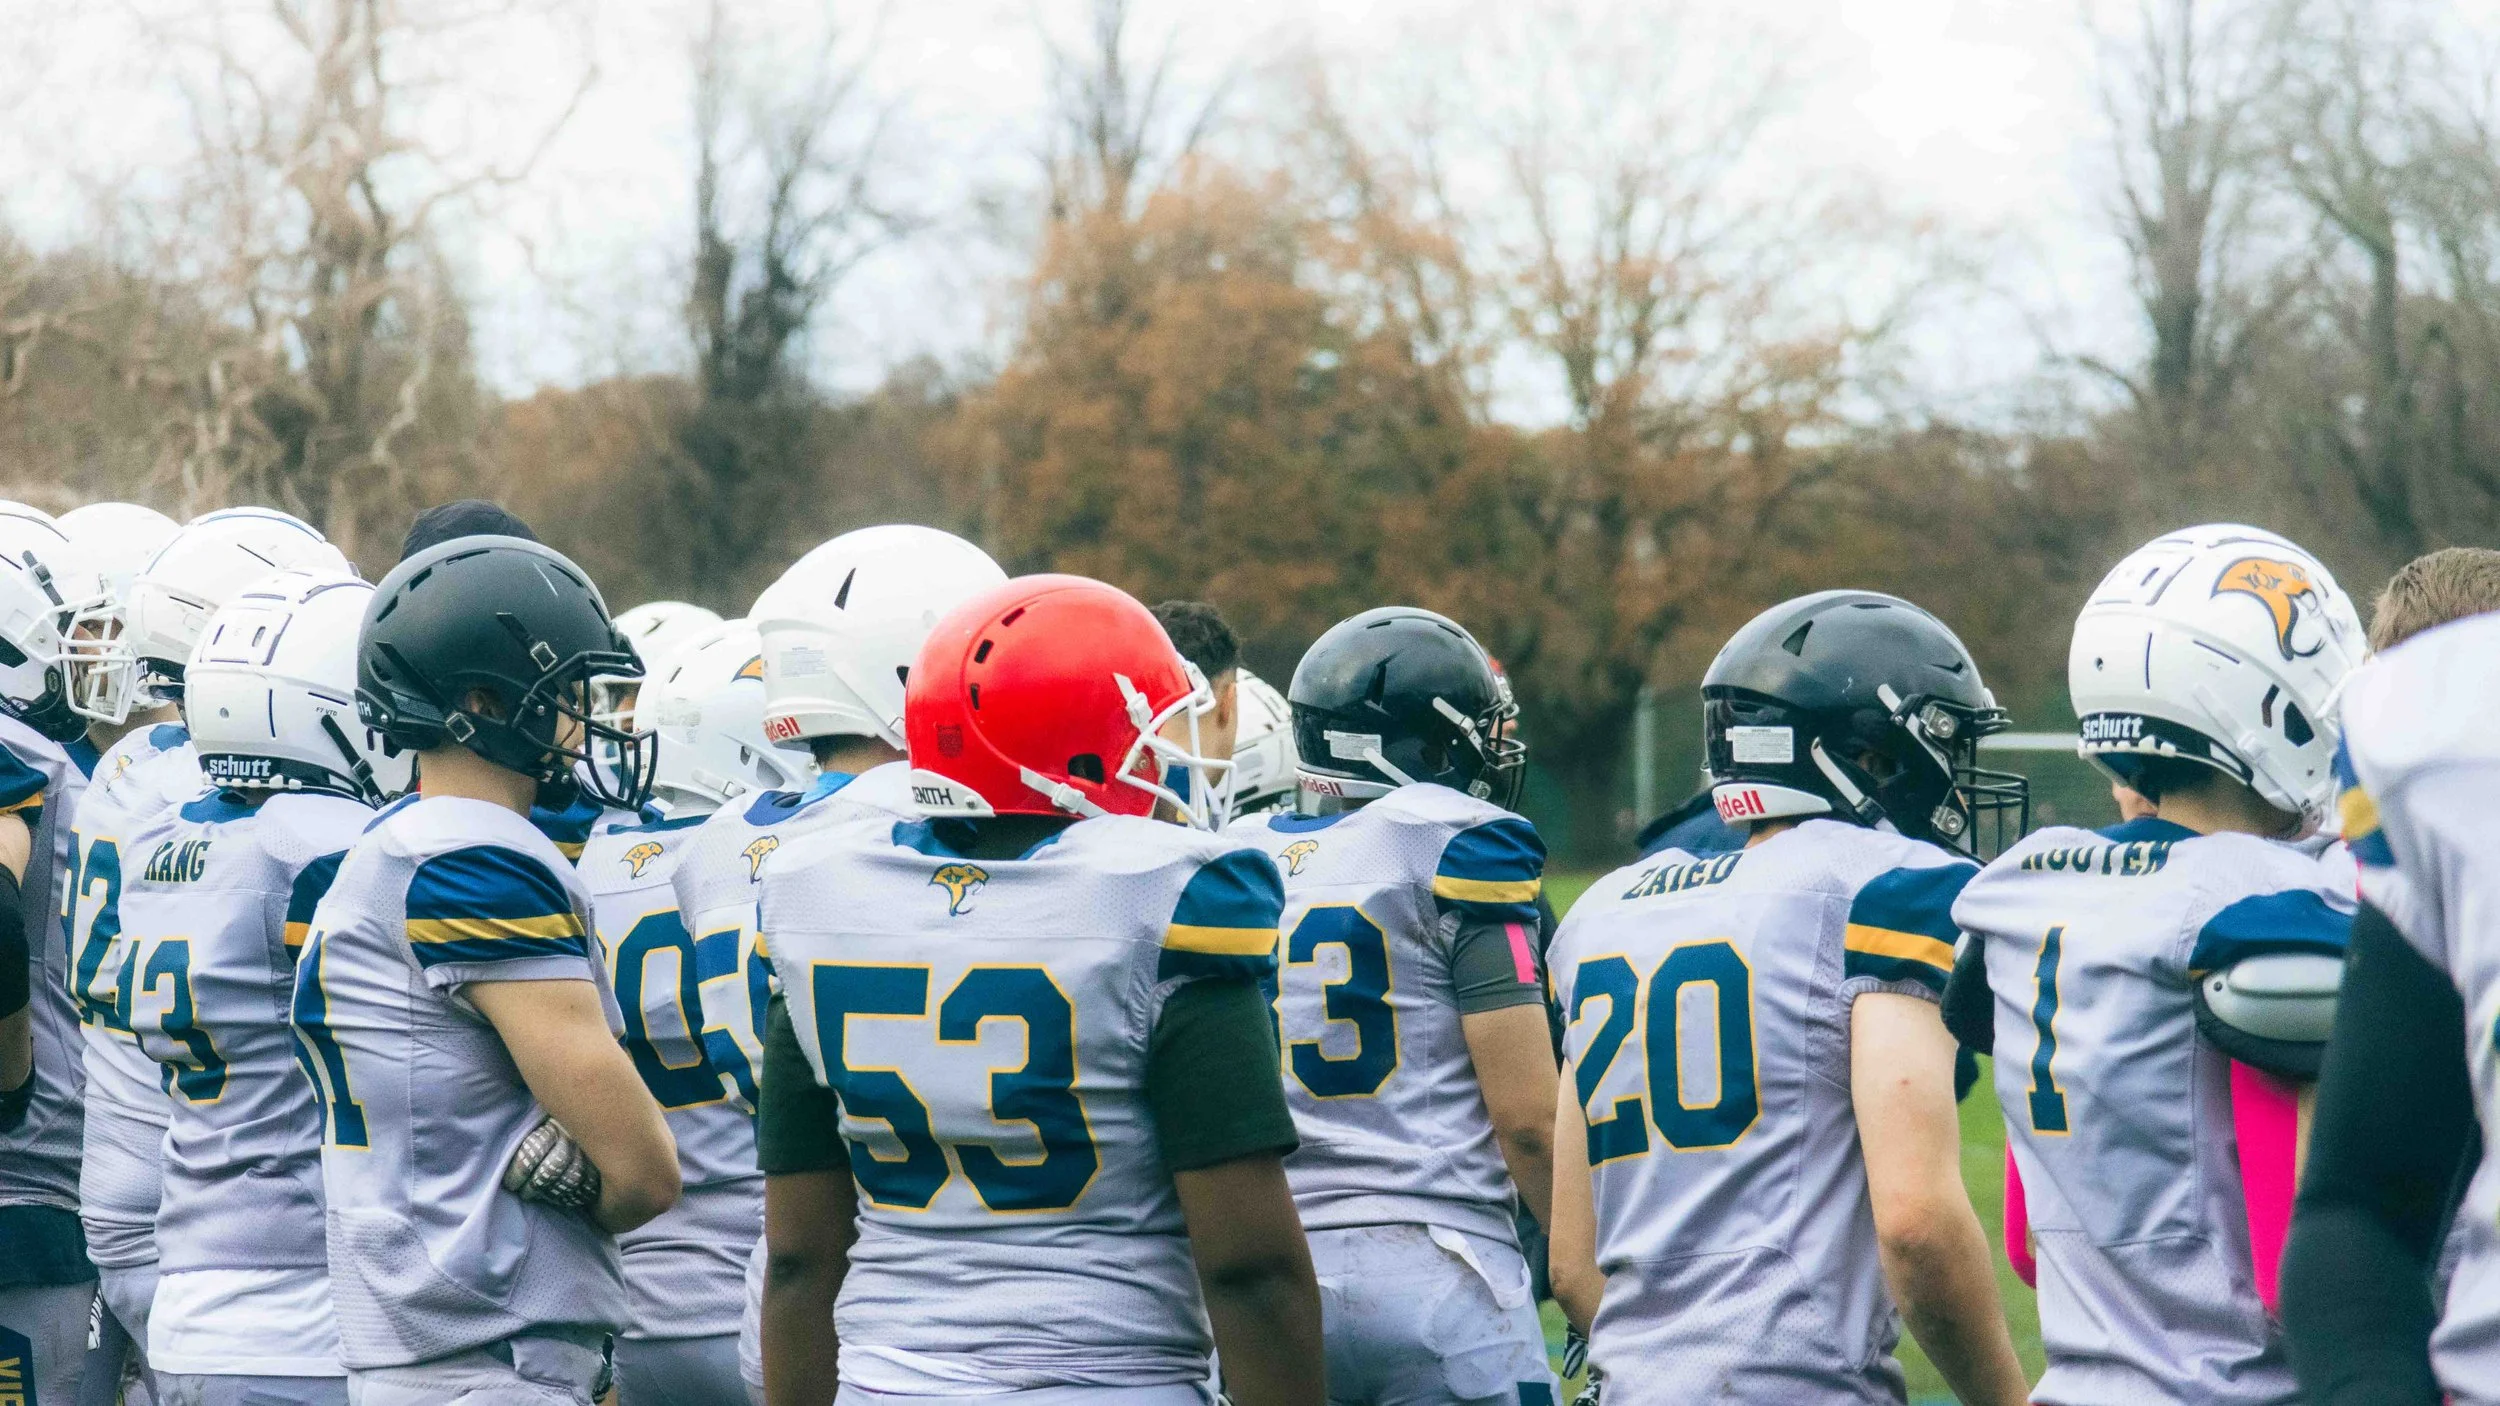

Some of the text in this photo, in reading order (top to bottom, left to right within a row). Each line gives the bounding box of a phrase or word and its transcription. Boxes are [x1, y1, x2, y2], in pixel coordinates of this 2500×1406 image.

[209, 755, 271, 777] schutt
[2082, 713, 2143, 740] schutt
[144, 840, 213, 882] KANG
[1620, 852, 1744, 901] ZAIED
[596, 906, 729, 1113] 0
[808, 958, 1104, 1215] 53
[1267, 901, 1403, 1102] 3
[1568, 937, 1763, 1168] 20
[2026, 921, 2071, 1136] 1
